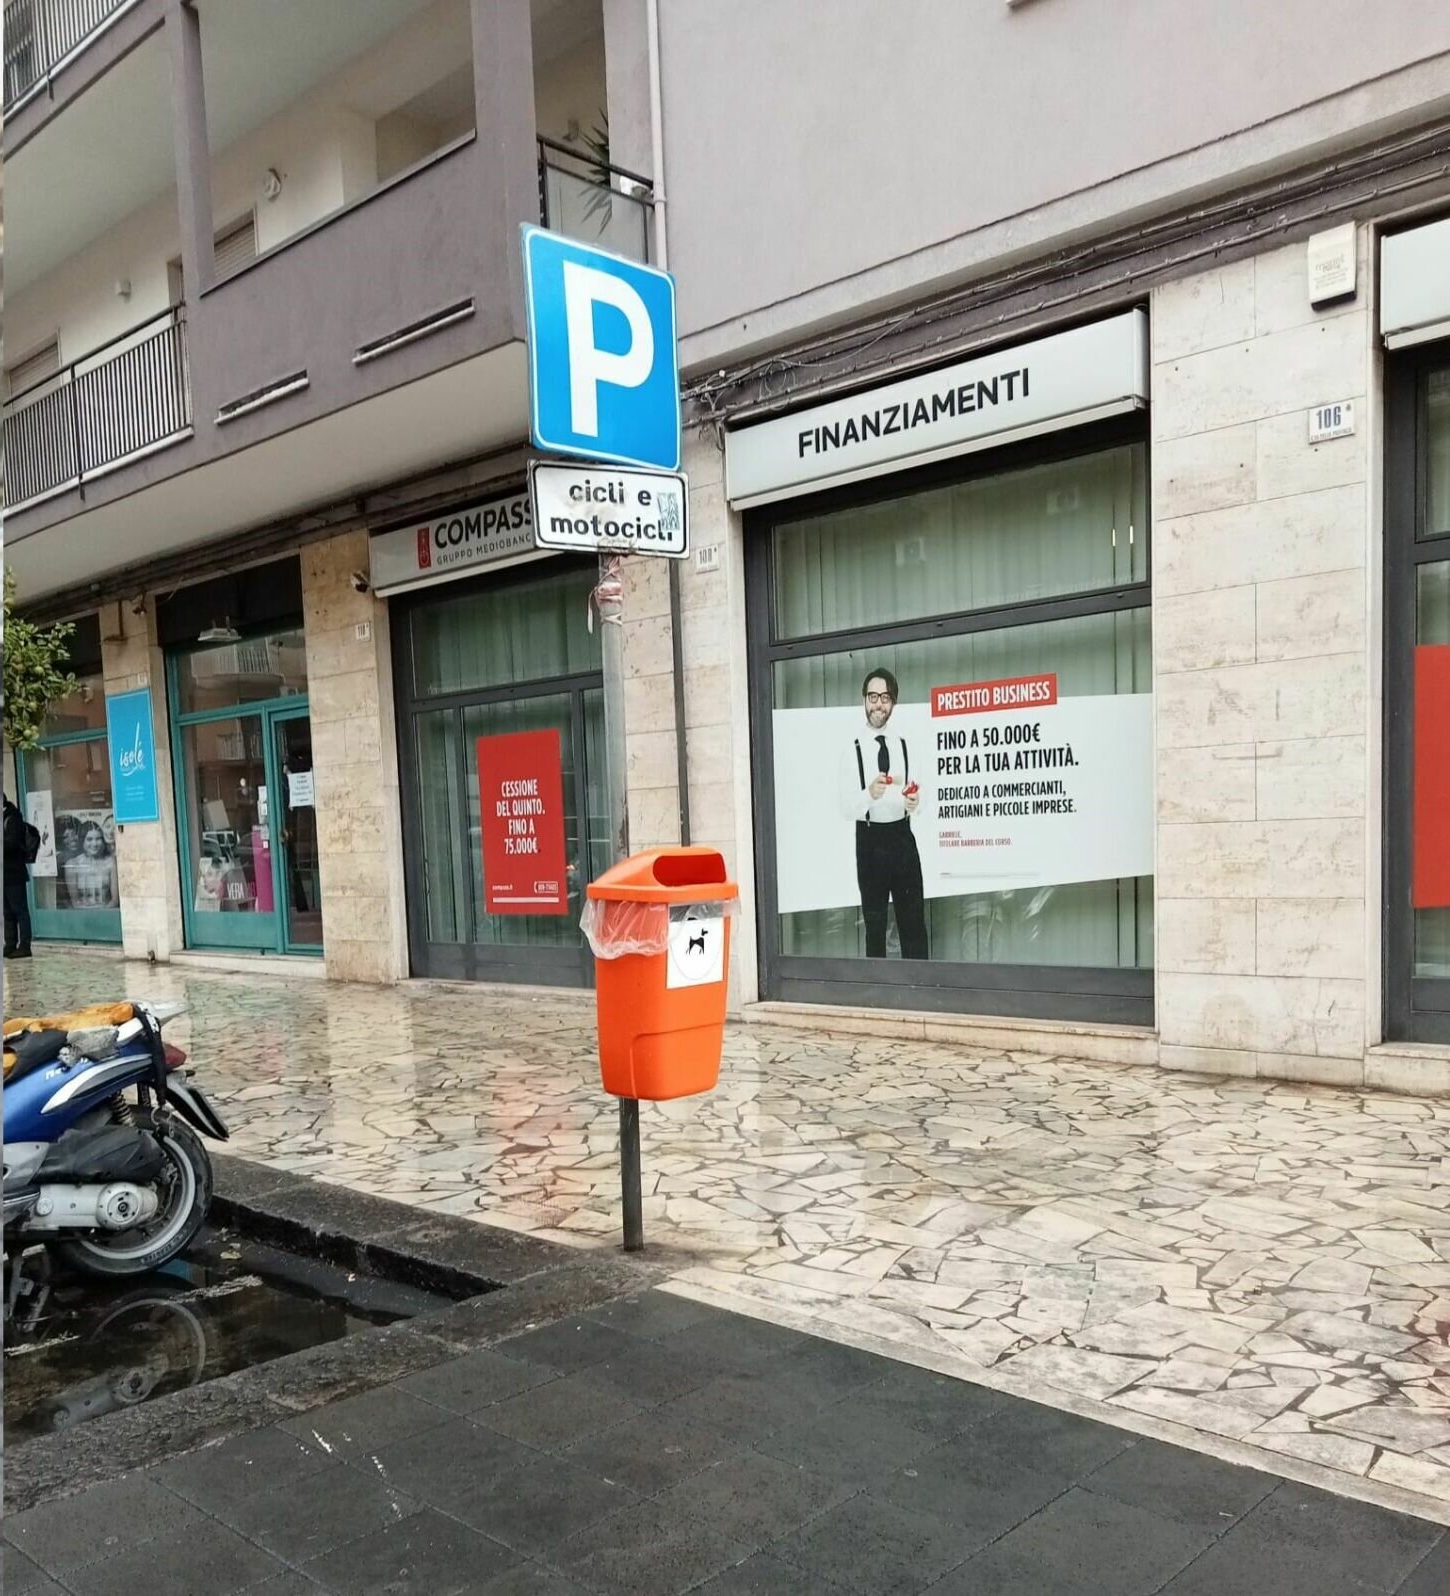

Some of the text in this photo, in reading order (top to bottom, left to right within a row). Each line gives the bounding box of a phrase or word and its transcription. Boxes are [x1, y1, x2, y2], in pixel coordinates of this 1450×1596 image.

[563, 259, 654, 438] P
[799, 368, 1029, 458] FINANZIAMENTI
[1316, 406, 1341, 430] 106
[569, 479, 651, 506] cicli e
[437, 533, 531, 565] GRUPPO MEDIOBANC
[937, 681, 1050, 711] PRESTITO BUSINESS
[937, 723, 1040, 751] FINO A 50.000€
[937, 743, 1079, 776] PER LA TUA ATTIVITÀ.
[501, 779, 538, 797] CESSIONE
[938, 780, 1066, 801] DEDICATO A COMMERCIANTI,
[496, 798, 546, 817] DEL QUINTO.
[938, 799, 1077, 819] ARTIGIANI E PICCOLE IMPRESE.
[508, 818, 535, 835] FINO A
[504, 837, 538, 855] 75.000€
[227, 882, 244, 899] VERA
